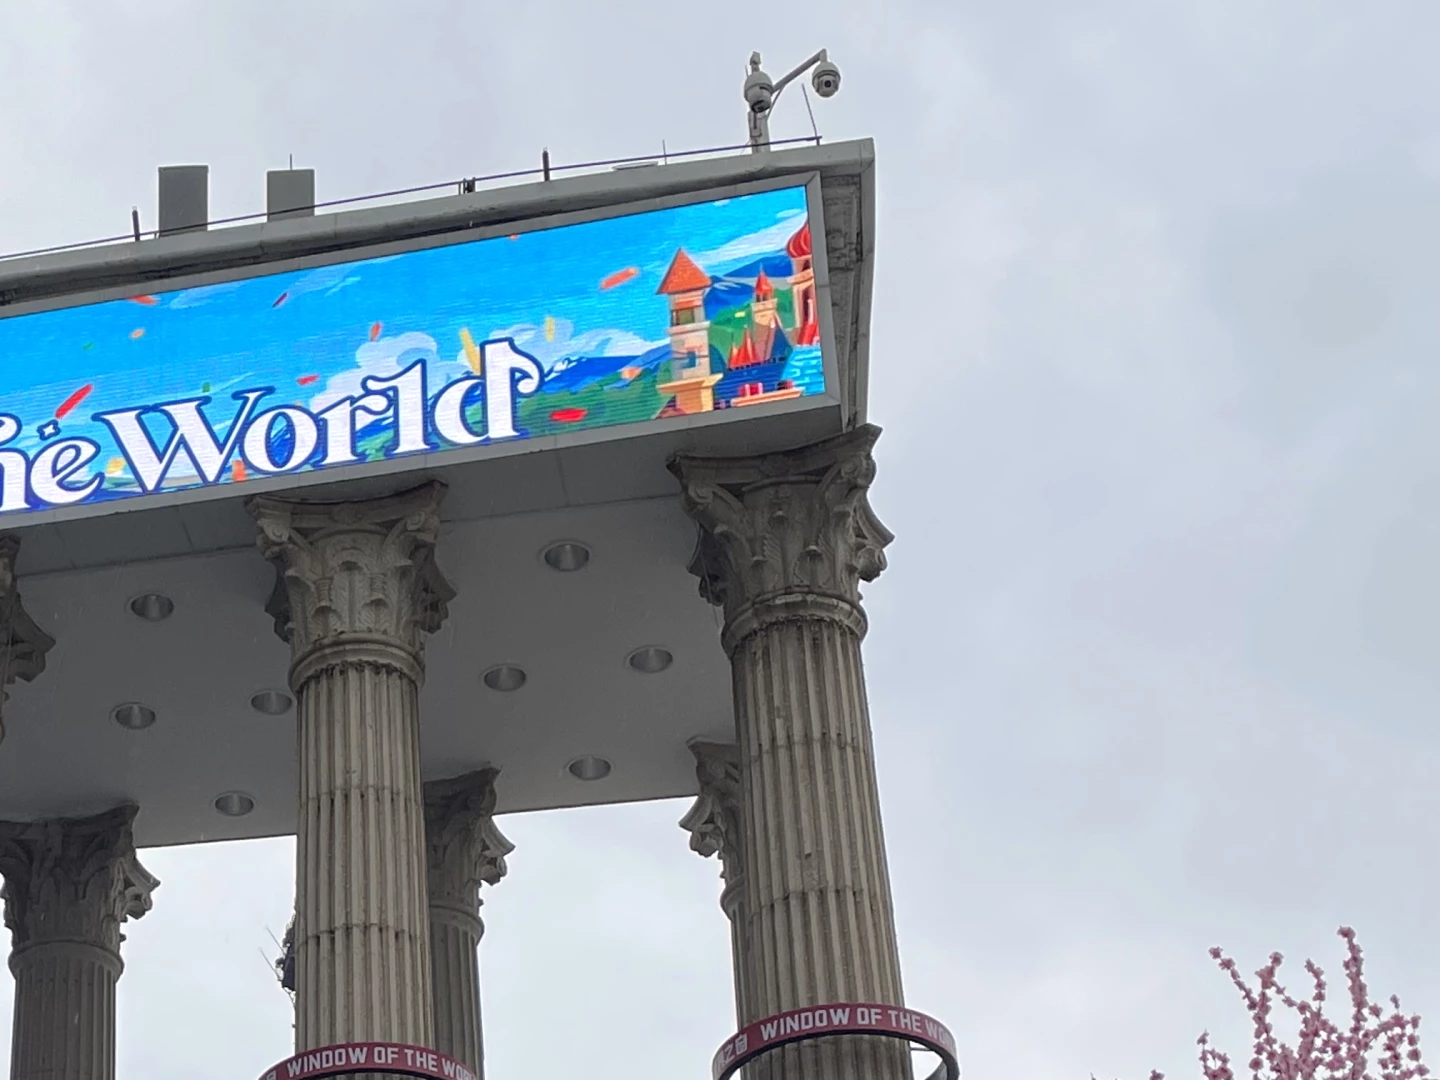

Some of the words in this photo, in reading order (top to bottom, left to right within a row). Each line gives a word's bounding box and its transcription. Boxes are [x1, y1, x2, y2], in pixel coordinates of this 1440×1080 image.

[98, 339, 543, 494] World
[760, 1007, 850, 1041] WINDOW
[856, 1007, 882, 1025] OF
[888, 1009, 923, 1033] THE
[286, 1047, 368, 1078] WINDOW
[373, 1046, 398, 1064] OF
[404, 1049, 438, 1072] THE
